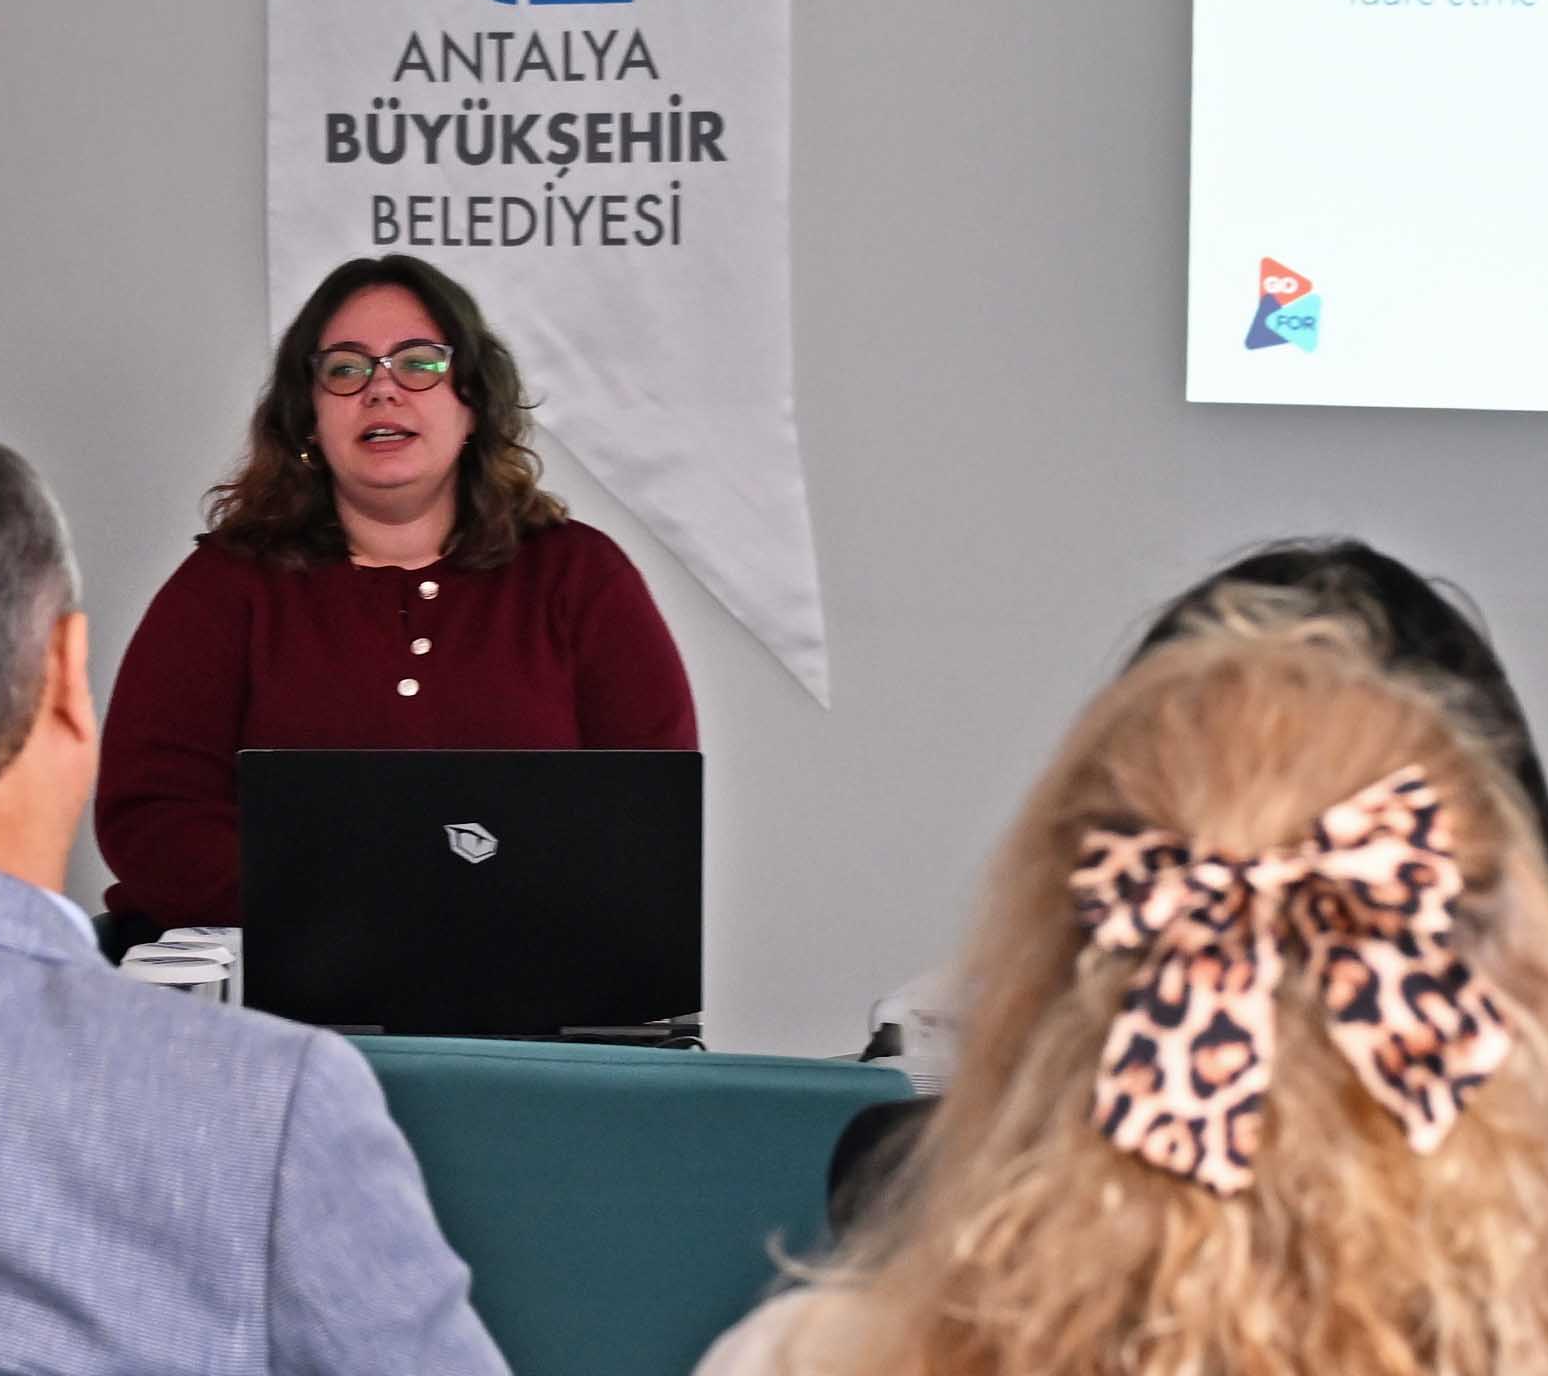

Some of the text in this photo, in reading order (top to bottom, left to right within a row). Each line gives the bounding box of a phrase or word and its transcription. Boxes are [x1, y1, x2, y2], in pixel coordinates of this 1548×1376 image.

[393, 27, 659, 82] ANTALYA
[324, 93, 727, 178] BÜYÜKŞEHİR
[371, 180, 681, 247] BELEDİYESİ
